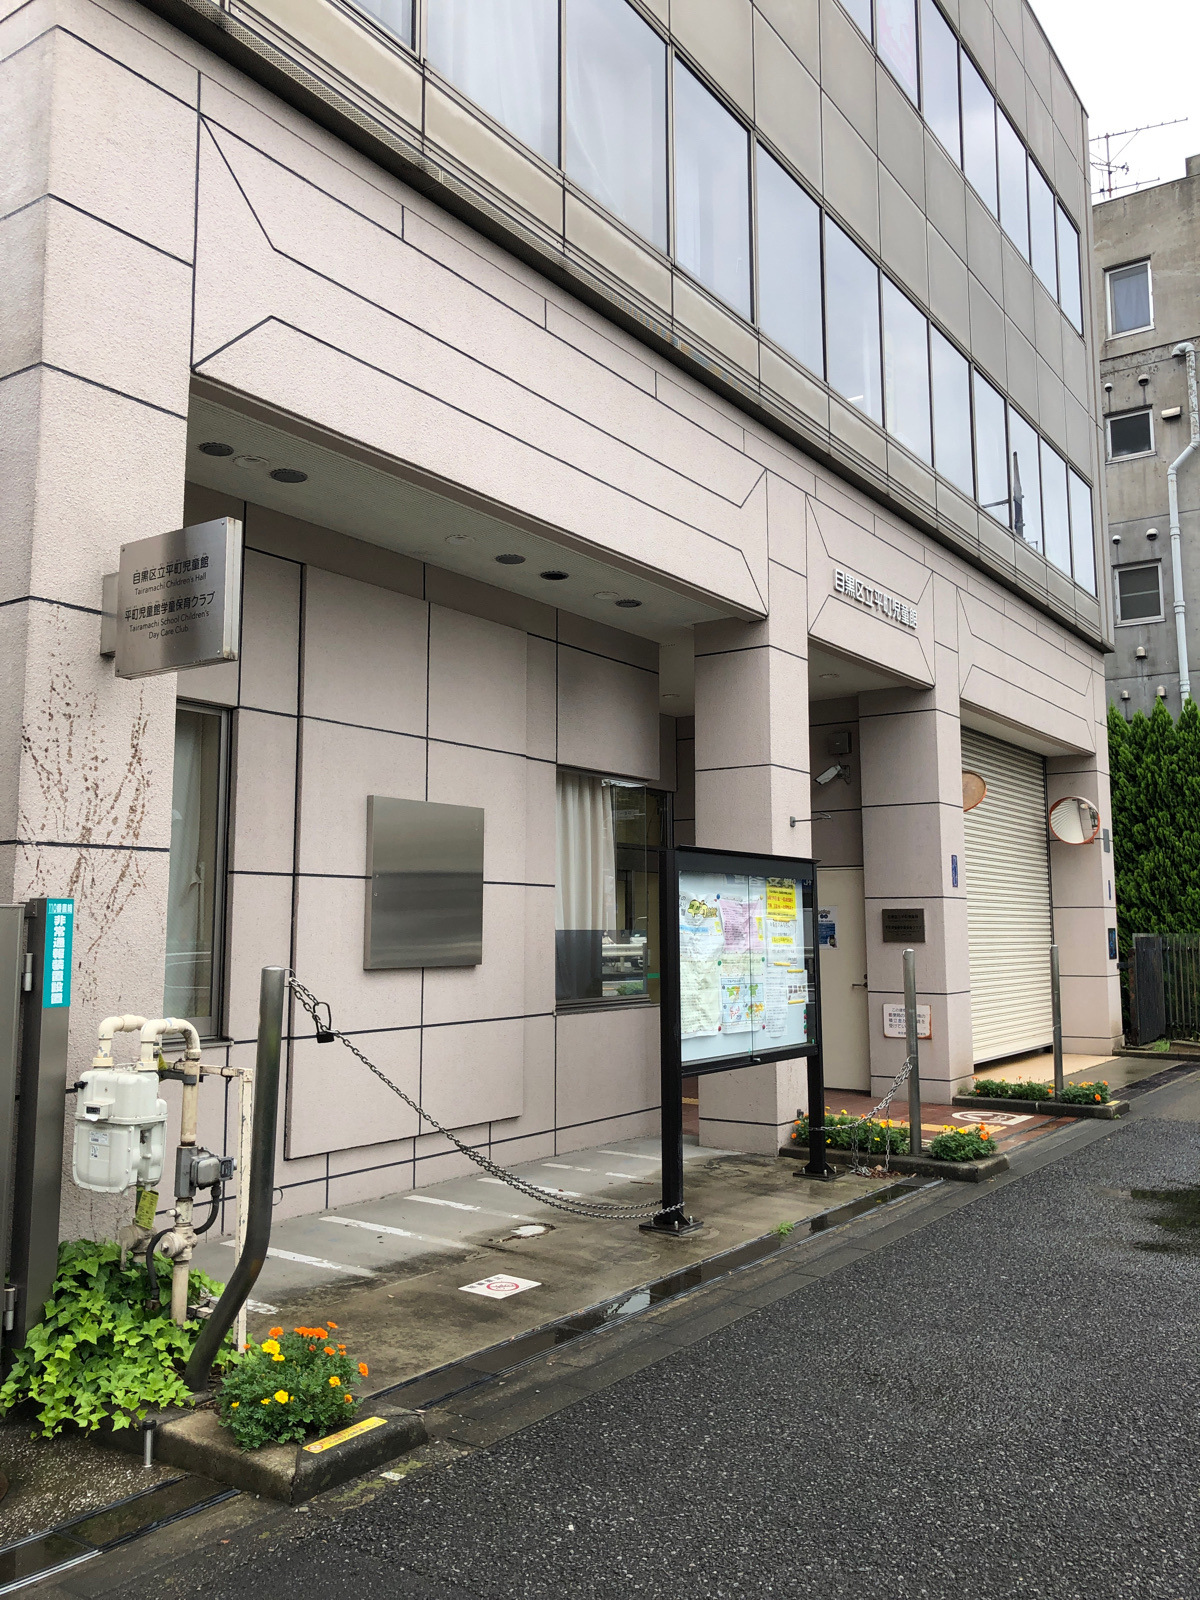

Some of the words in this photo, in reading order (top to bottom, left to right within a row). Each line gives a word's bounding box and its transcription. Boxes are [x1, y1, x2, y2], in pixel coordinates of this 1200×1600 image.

[133, 555, 209, 585] 目黒区立平町児童館
[134, 582, 165, 596] Tairamachi
[166, 576, 194, 588] Children's
[195, 571, 207, 581] Hall
[125, 591, 216, 621] 平町児童館学童保育クラブ
[834, 568, 918, 630] 目黒区立平町児童館
[129, 620, 159, 633] Tairamachi
[160, 614, 179, 626] School
[180, 610, 210, 622] Children's
[148, 631, 159, 640] Day
[160, 628, 174, 637] Care
[174, 625, 189, 634] Club
